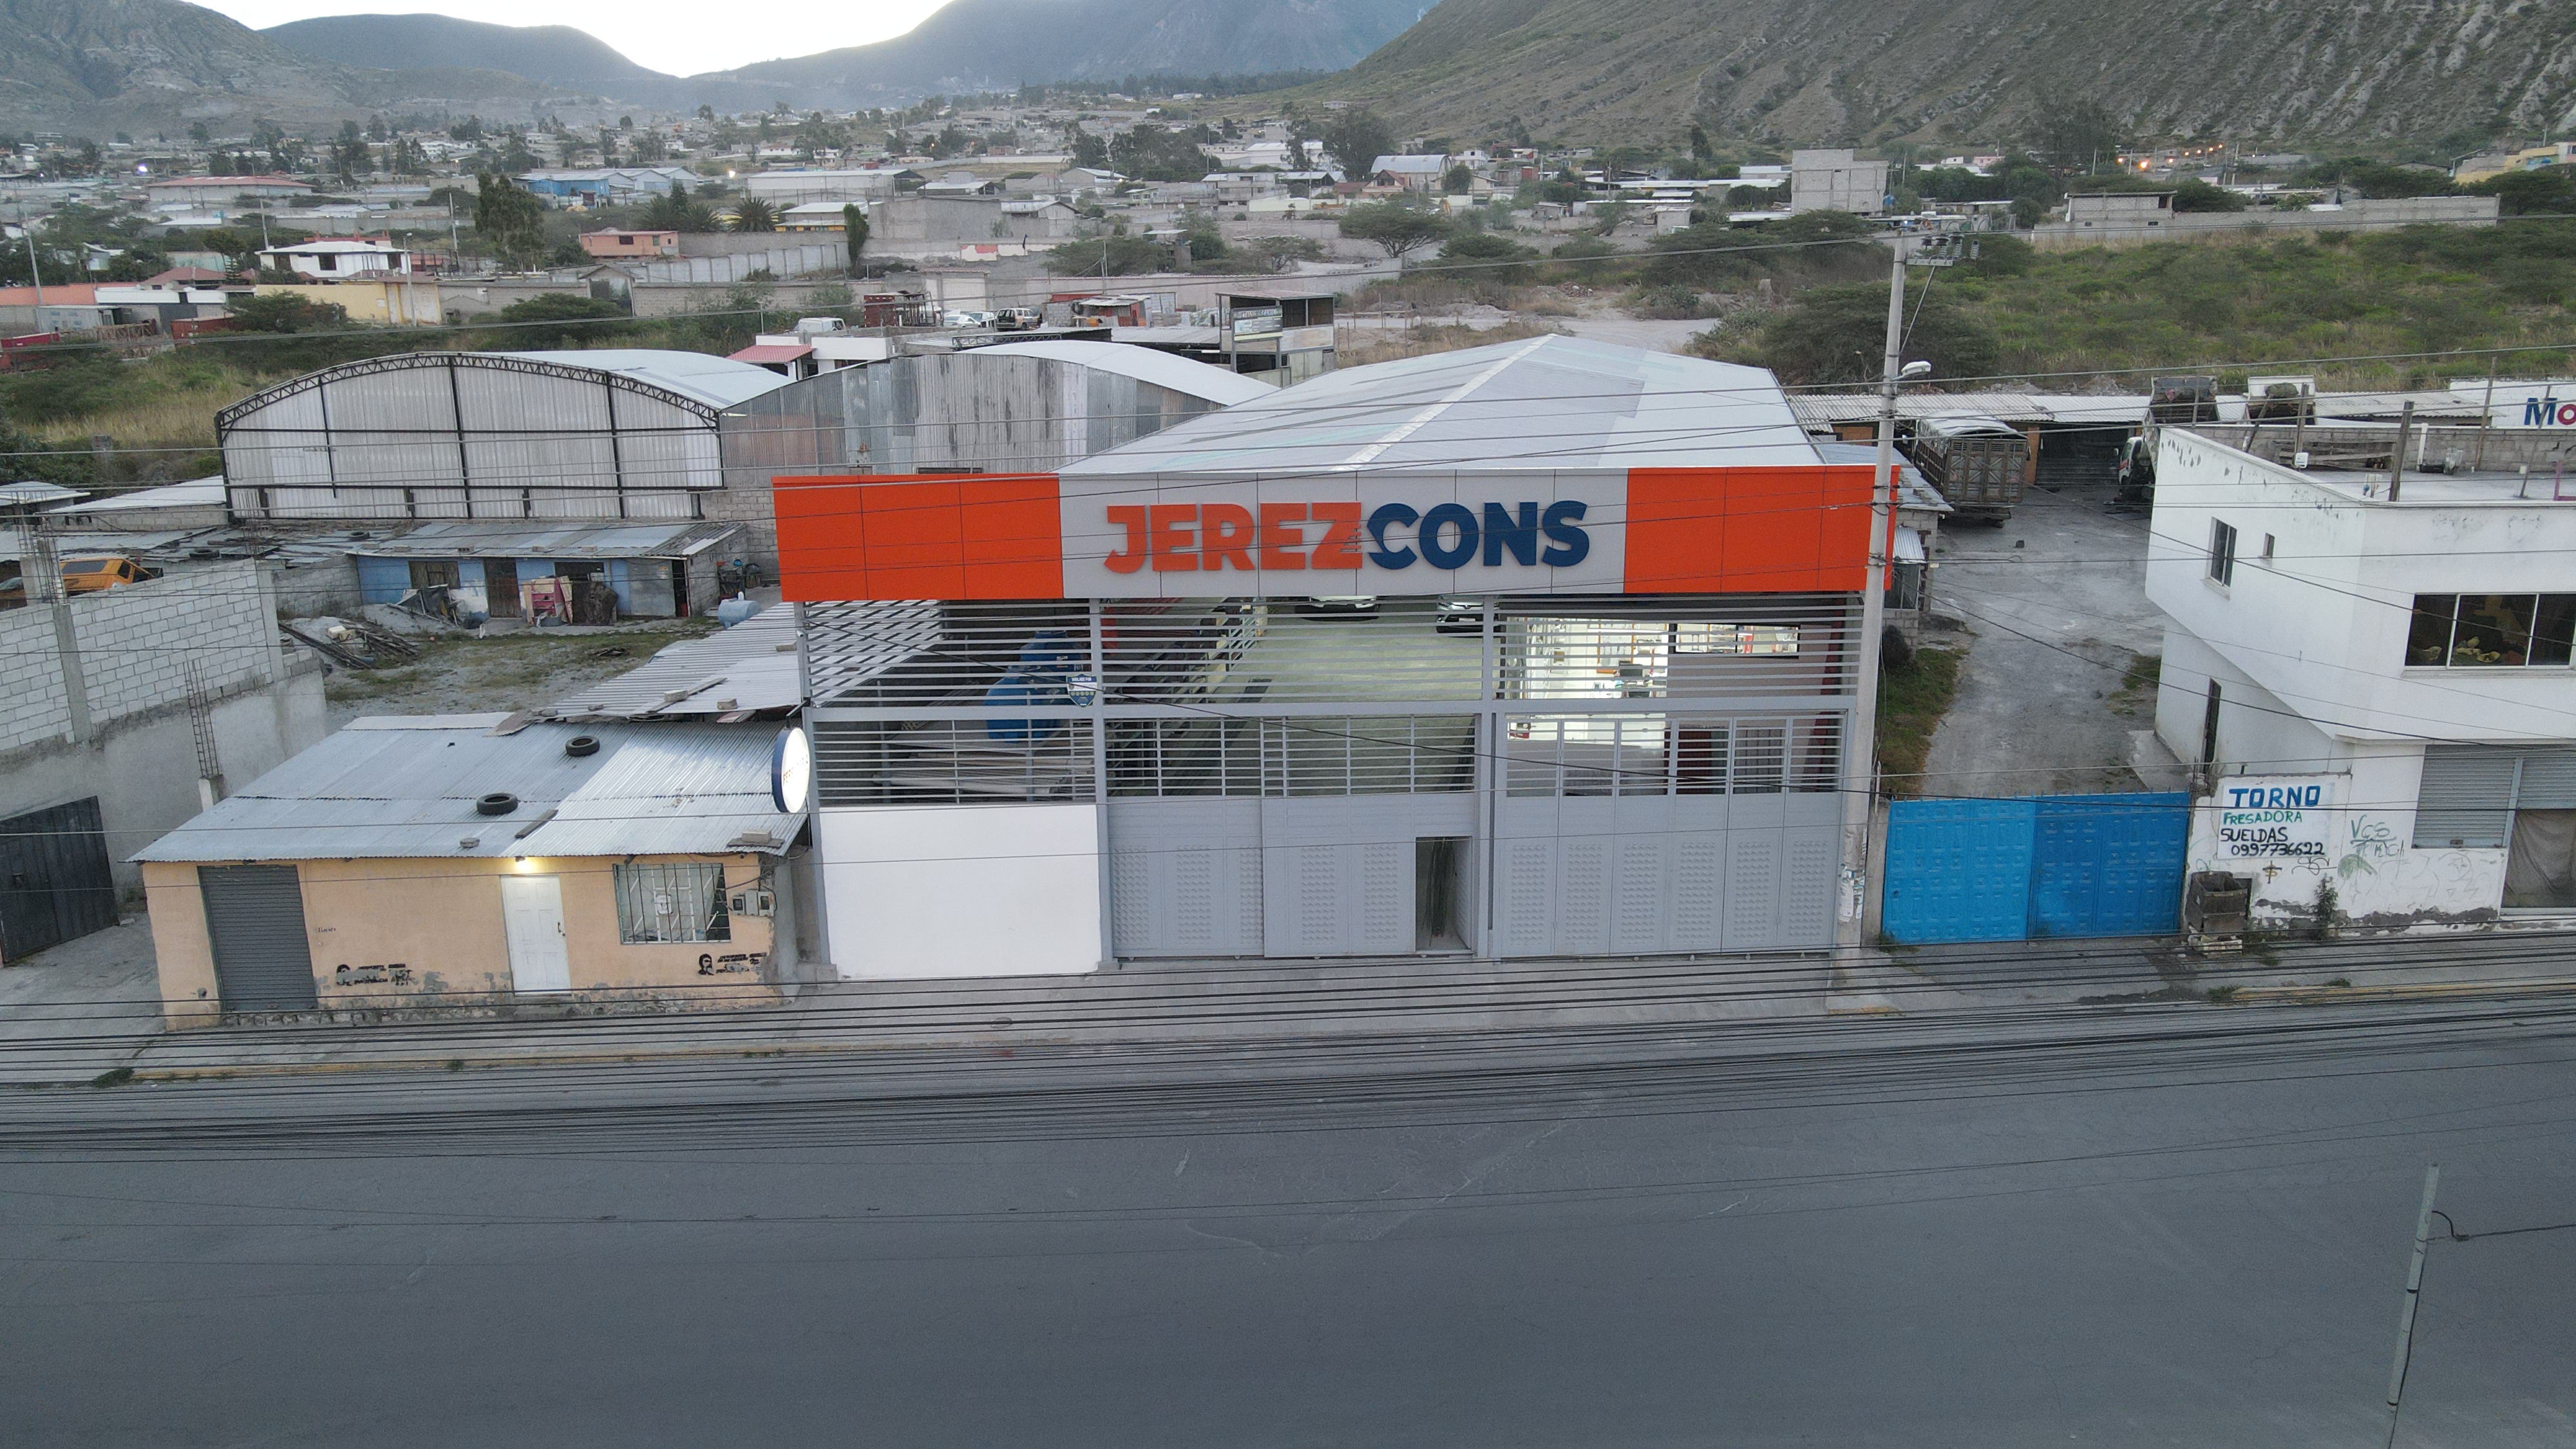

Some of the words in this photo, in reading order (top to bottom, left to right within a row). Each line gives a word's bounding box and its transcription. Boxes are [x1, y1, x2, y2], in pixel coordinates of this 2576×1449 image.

[2228, 785, 2321, 809] TORNO
[2223, 810, 2302, 825] FRESADORA
[2220, 826, 2289, 843] SUELDAS
[2231, 842, 2325, 857] 0997736622
